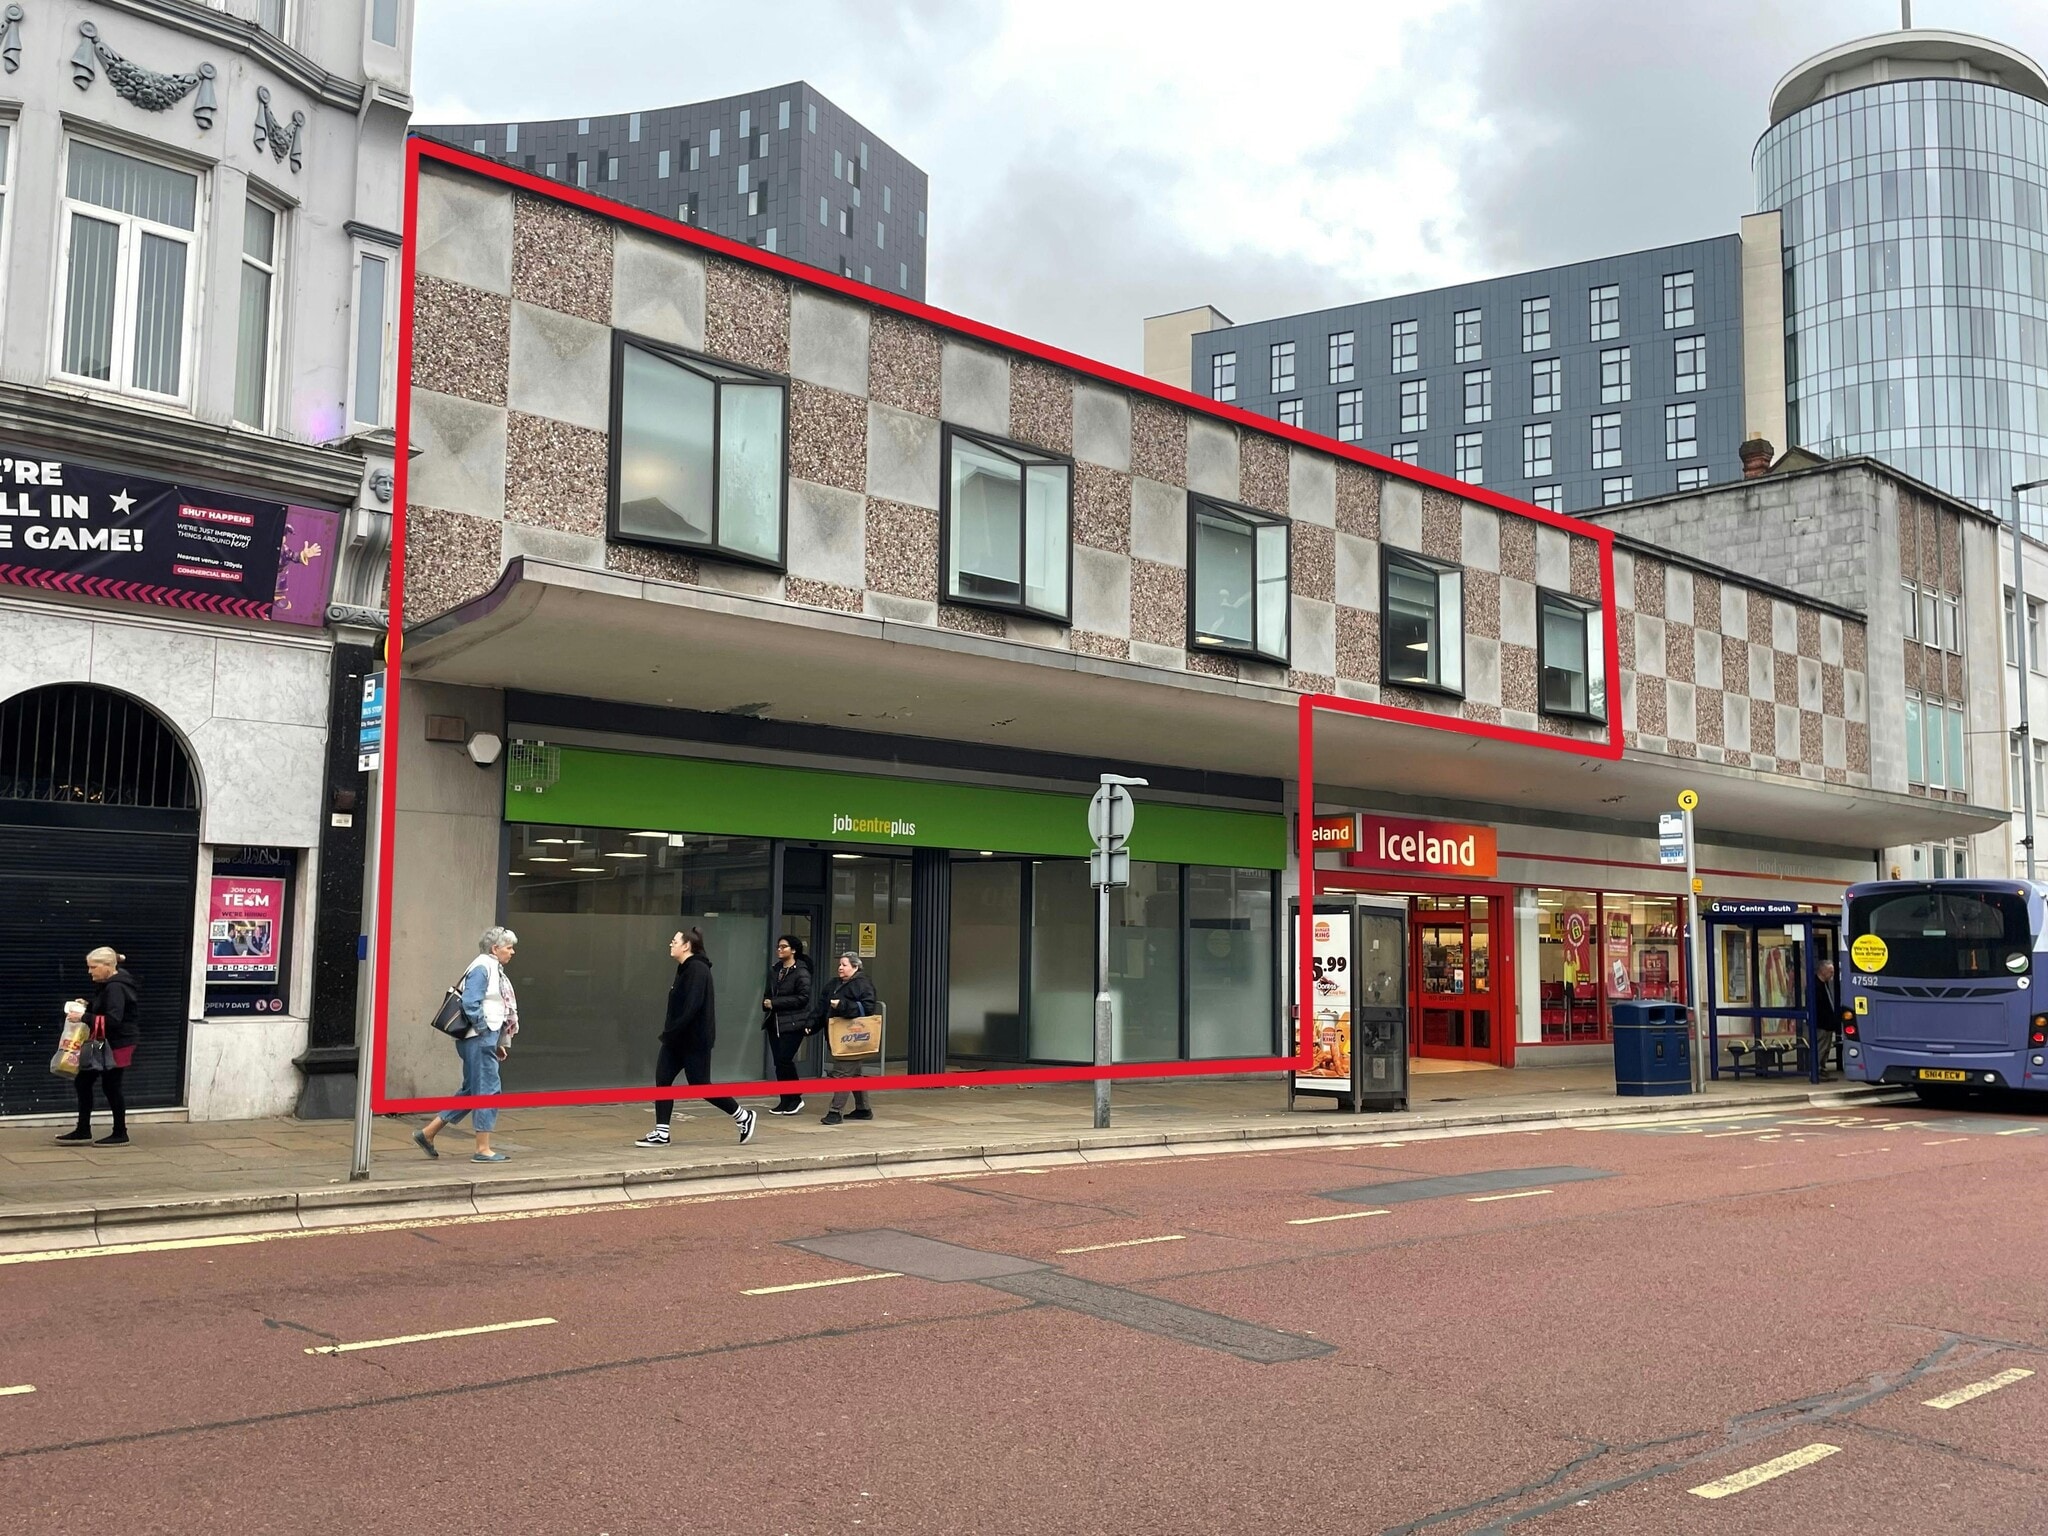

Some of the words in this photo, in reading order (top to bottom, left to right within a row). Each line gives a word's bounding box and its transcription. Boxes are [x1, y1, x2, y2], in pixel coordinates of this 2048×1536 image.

[0, 458, 63, 486] 'RE
[51, 494, 89, 519] IN
[182, 507, 207, 518] SHUT
[208, 511, 251, 524] HAPPENS
[24, 525, 144, 552] GAME!
[177, 523, 198, 533] WE'RE
[199, 526, 214, 535] JUST
[214, 530, 252, 541] IMPROVING
[177, 530, 202, 540] THINGS
[202, 536, 231, 545] AROUND
[177, 567, 220, 578] COMMERCIAL
[221, 572, 240, 580] ROAD
[1683, 794, 1692, 805] G
[832, 813, 916, 838] jobcentreplus
[1379, 826, 1476, 867] Iceland
[1711, 902, 1721, 912] G
[1721, 904, 1738, 913] City
[1739, 904, 1766, 912] Centre
[1767, 904, 1791, 912] South
[1969, 949, 1978, 970] 1
[1852, 976, 1878, 986] 47592
[1924, 1070, 1943, 1079] SN14
[1944, 1072, 1961, 1080] ECW
